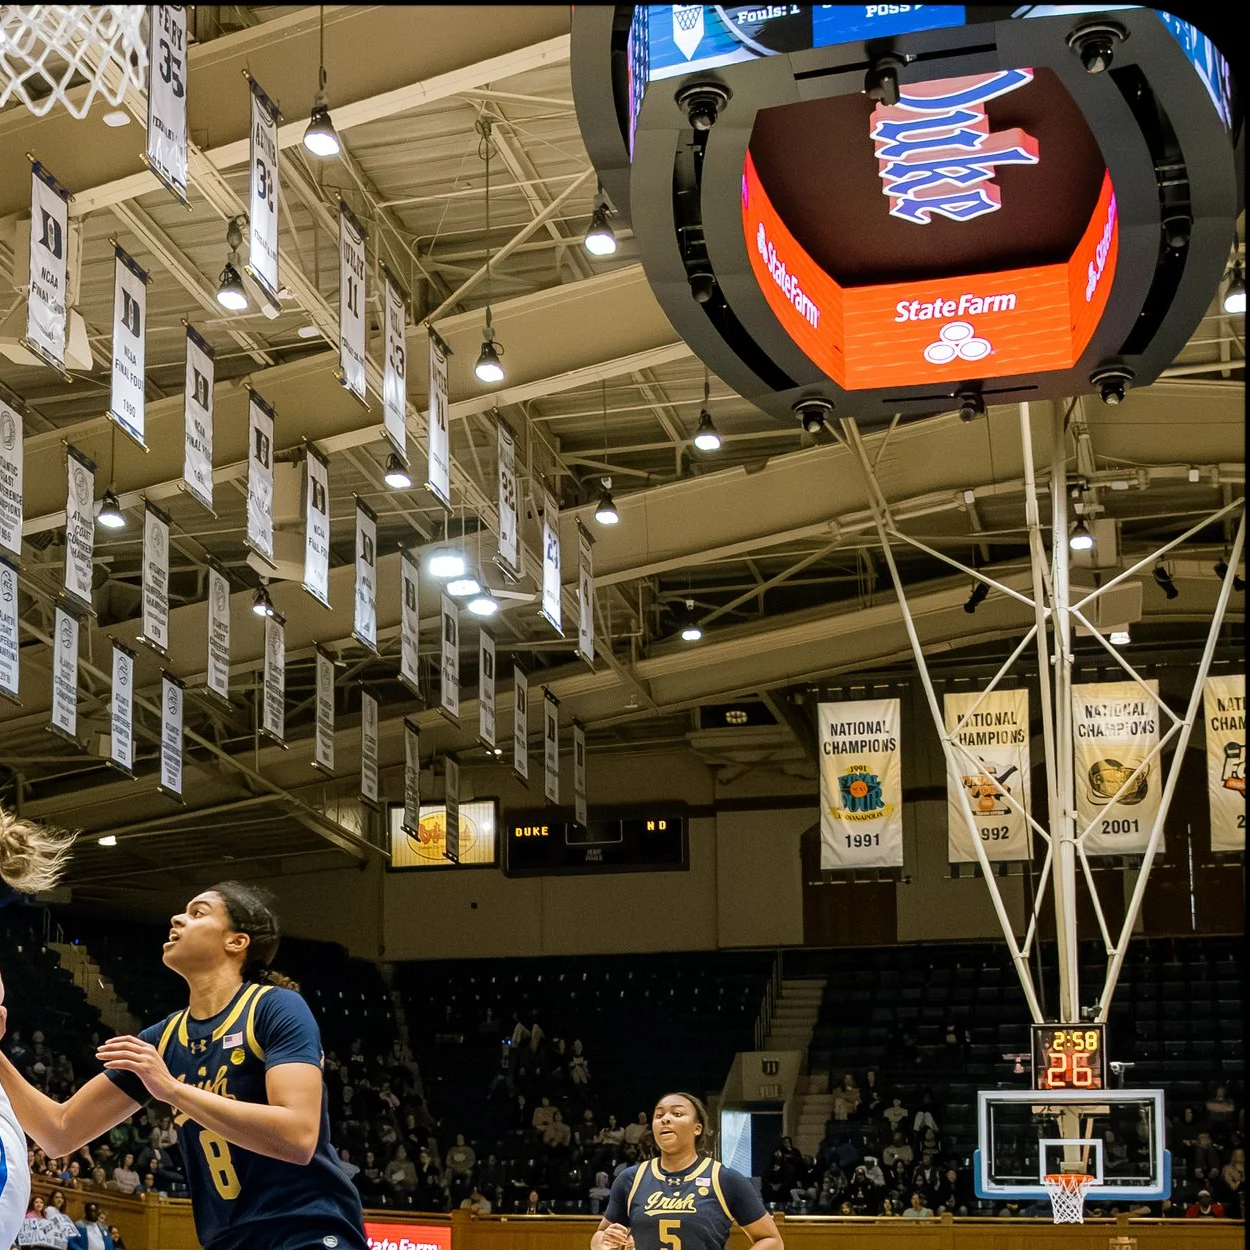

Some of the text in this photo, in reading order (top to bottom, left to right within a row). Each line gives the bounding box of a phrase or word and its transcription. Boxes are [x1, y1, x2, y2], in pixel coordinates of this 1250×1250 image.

[159, 39, 184, 99] 35
[41, 266, 59, 290] NCAA
[115, 358, 130, 383] FINAL
[1085, 702, 1147, 719] NATIONAL
[830, 719, 889, 737] NATIONAL
[1078, 720, 1155, 738] CHAMPIONS
[957, 729, 1026, 746] HAMPIONS
[823, 738, 897, 756] CHAMPIONS
[849, 765, 868, 773] 1991
[515, 826, 549, 838] DUKE
[981, 826, 1010, 841] 992
[1102, 819, 1140, 834] 2001
[844, 833, 880, 848] 1991
[1053, 1031, 1098, 1051] 2:58
[1048, 1053, 1093, 1086] 26
[199, 1130, 242, 1200] 8
[644, 1191, 697, 1217] Irish
